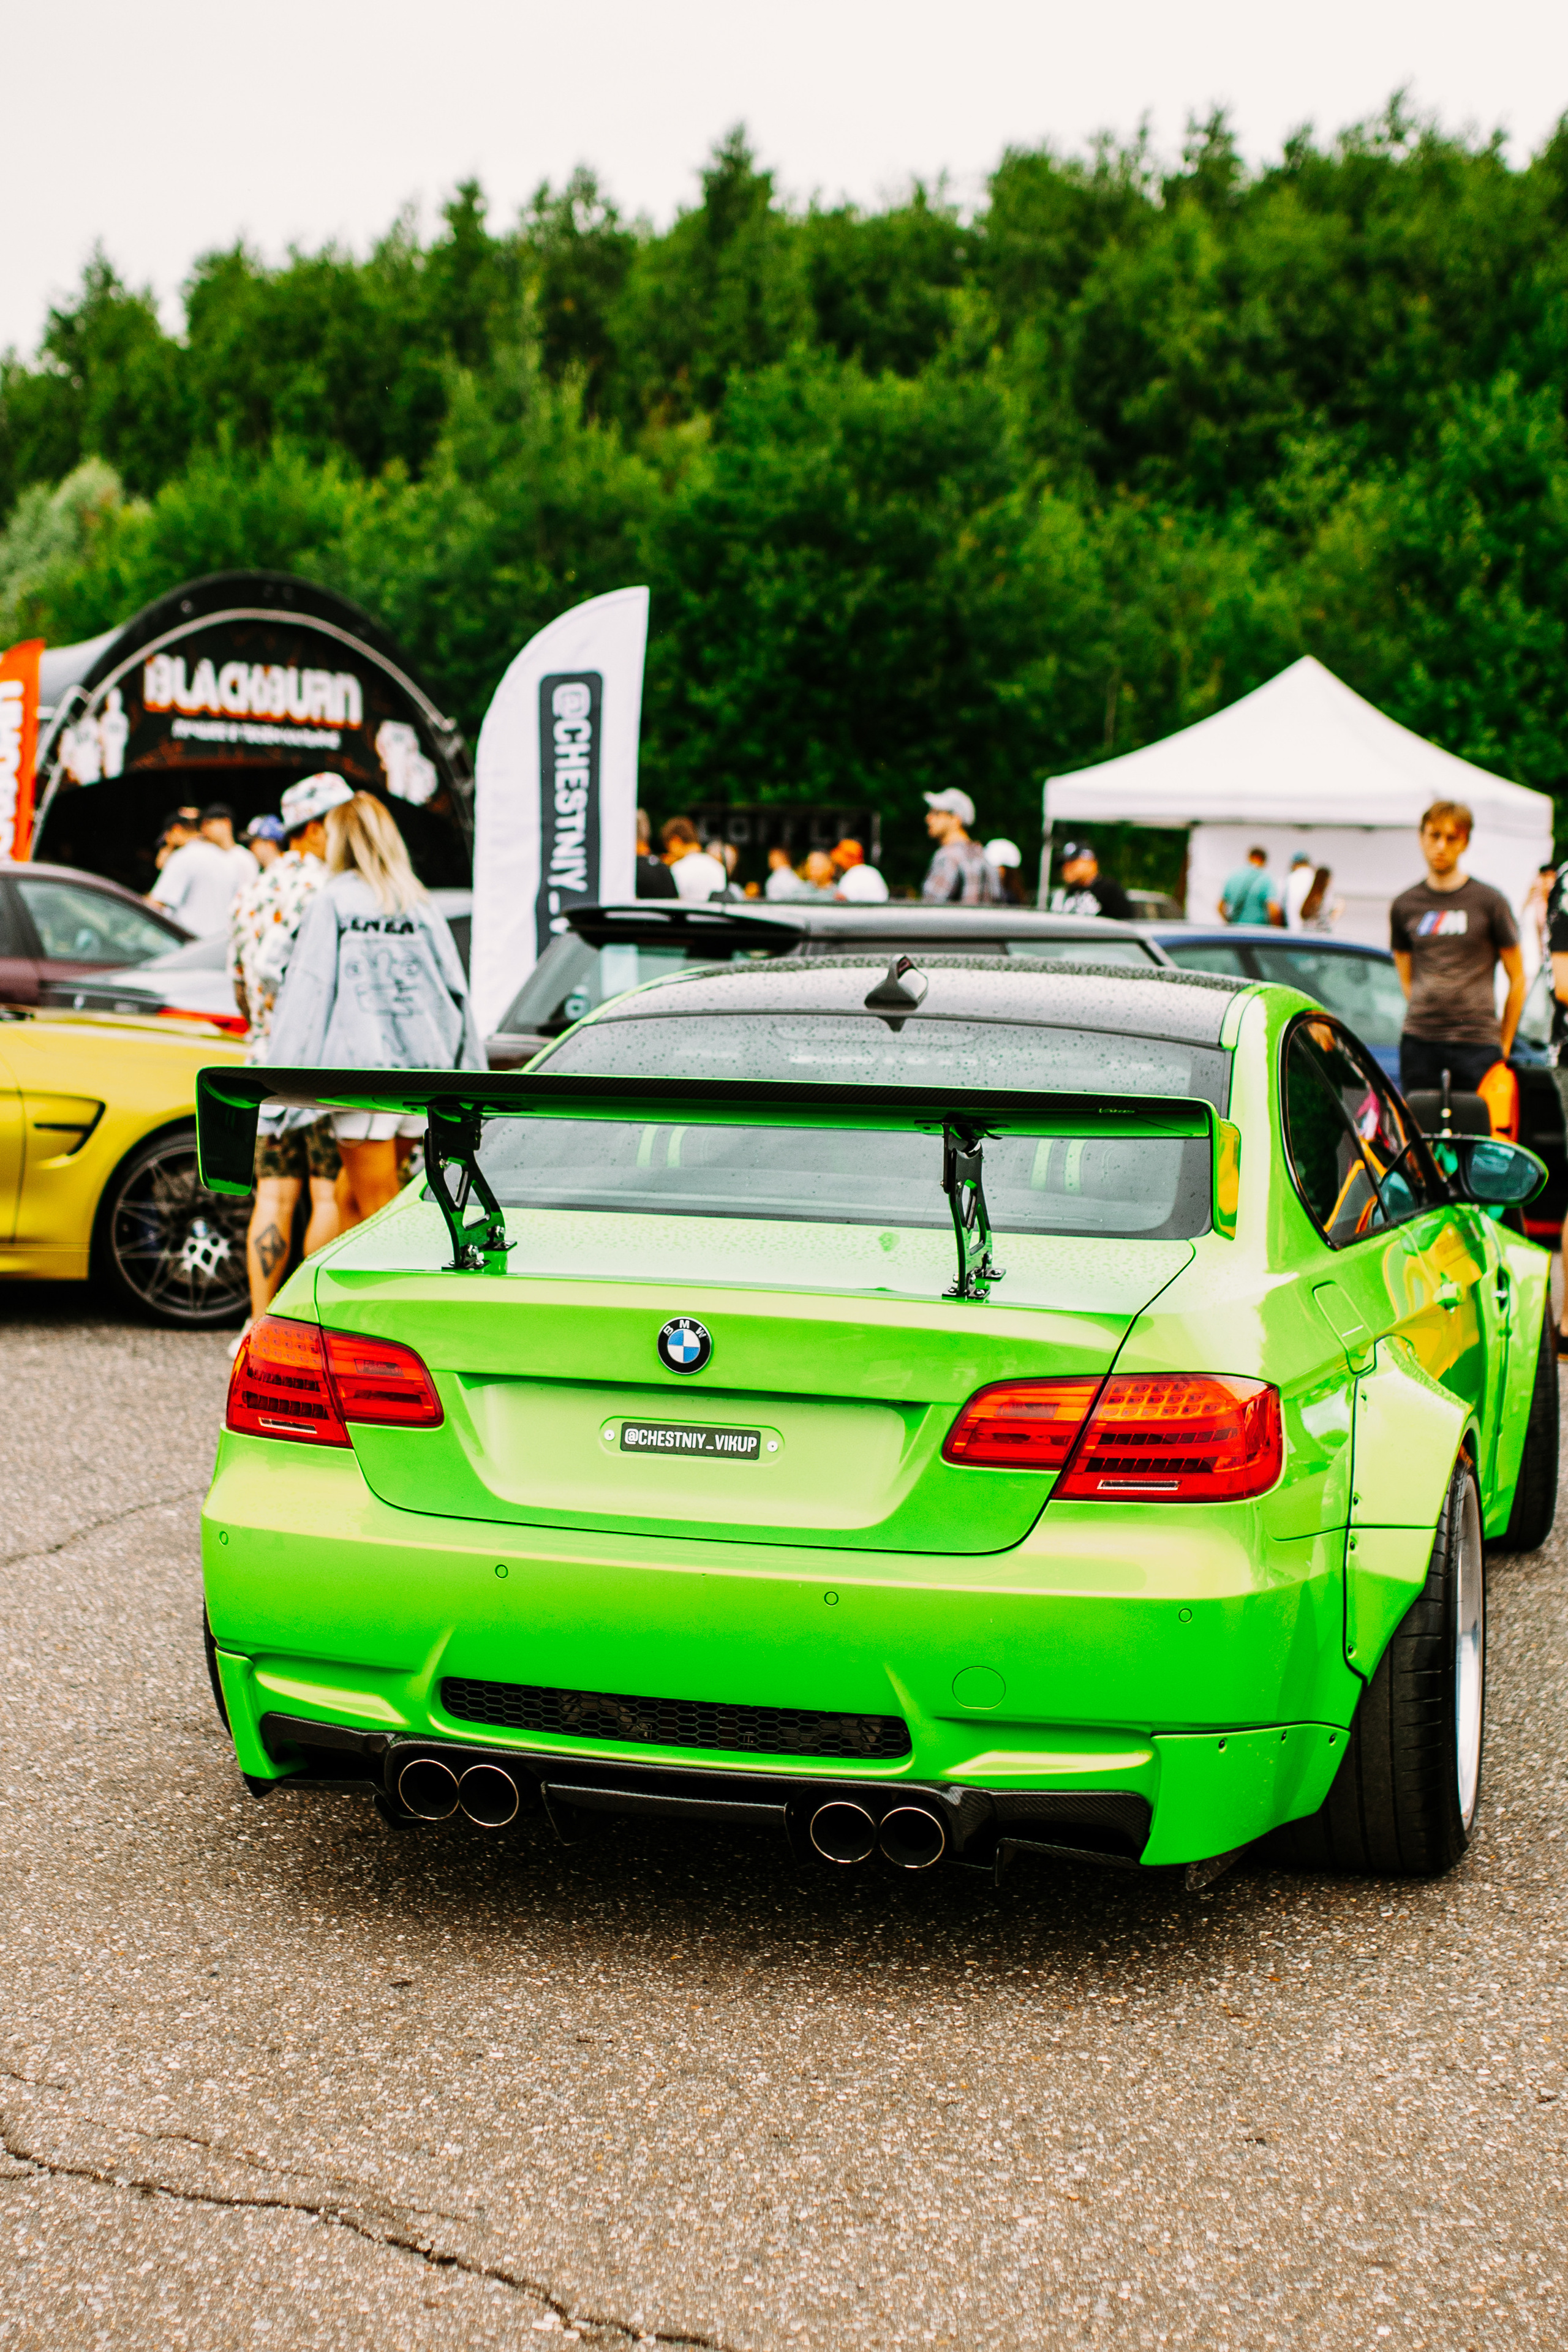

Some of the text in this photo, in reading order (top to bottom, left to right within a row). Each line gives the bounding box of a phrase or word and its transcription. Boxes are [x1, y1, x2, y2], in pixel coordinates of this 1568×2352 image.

[144, 652, 364, 729] BLACKBURN
[663, 1319, 707, 1338] BMW
[624, 1428, 758, 1452] @CHESTNIY_VIKUP
